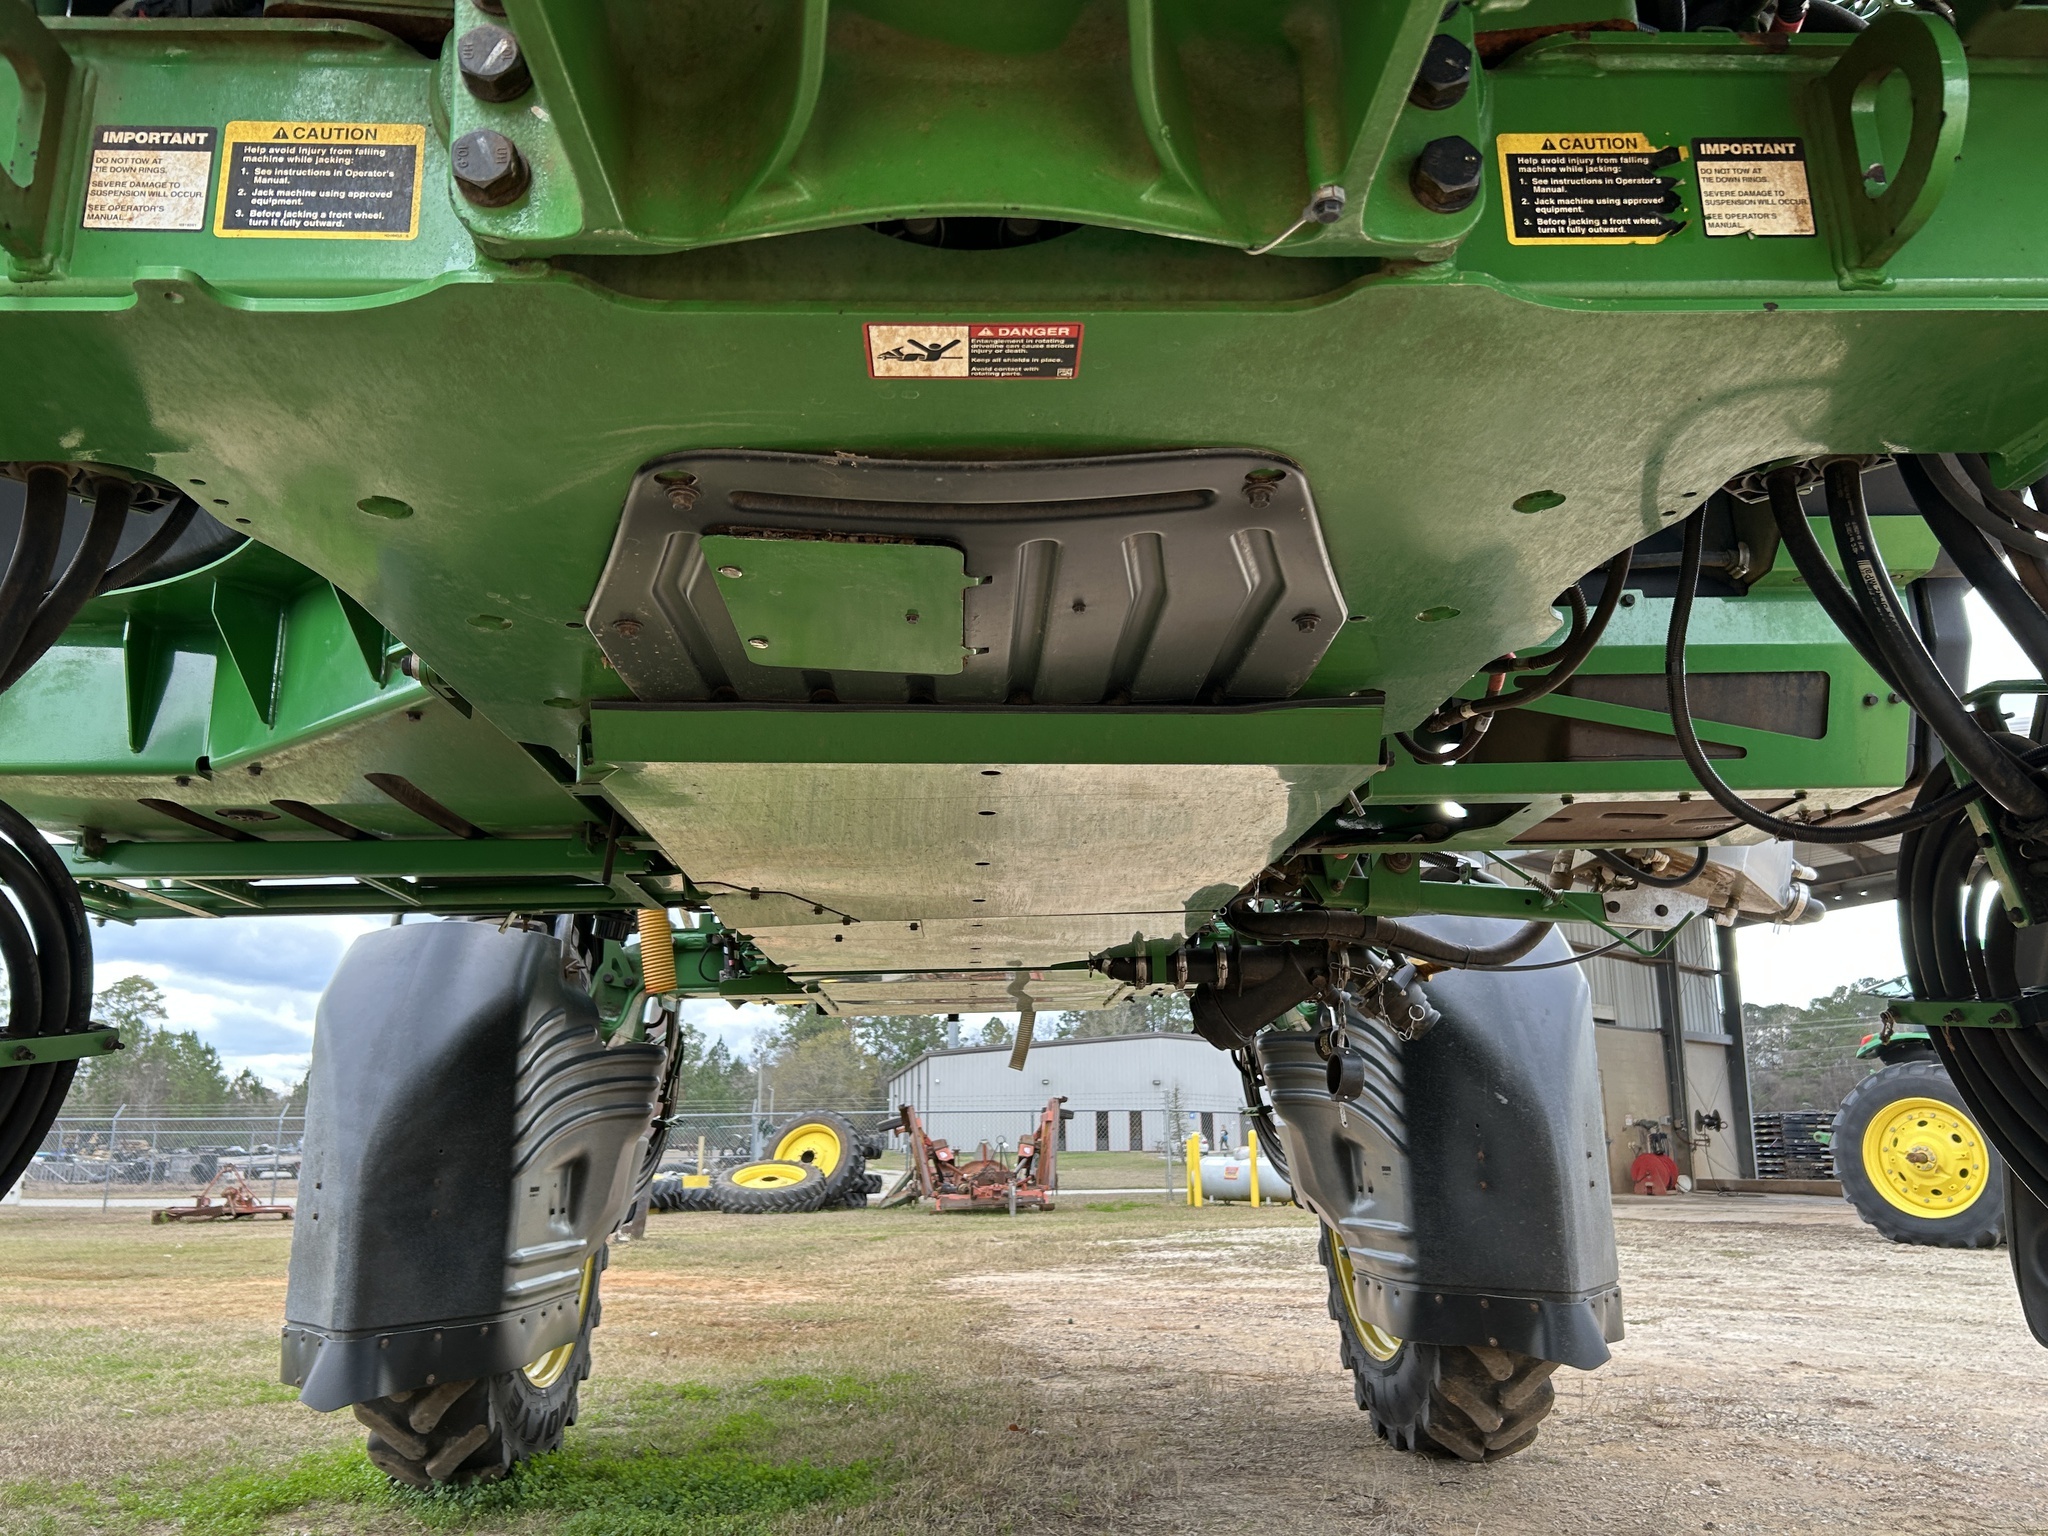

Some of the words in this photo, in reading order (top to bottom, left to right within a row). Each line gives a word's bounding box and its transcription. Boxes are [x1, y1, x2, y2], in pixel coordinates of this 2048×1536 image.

[103, 131, 208, 144] IMPORTANT
[293, 127, 377, 140] CAUTION
[1559, 138, 1637, 150] CAUTION
[1700, 143, 1796, 154] IMPORTANT
[244, 146, 266, 154] Help
[298, 147, 326, 156] injury
[354, 148, 386, 156] falling
[243, 155, 284, 163] machine
[315, 156, 354, 165] jacking:
[1517, 157, 1538, 165] Help
[1568, 157, 1593, 165] injury
[1620, 157, 1649, 165] falling
[254, 168, 272, 176] See
[274, 168, 331, 177] instructions
[333, 169, 343, 177] in
[345, 170, 394, 178] Operator's
[1585, 166, 1622, 174] jacking:
[1615, 178, 1662, 186] Operator's
[319, 190, 345, 199] using
[347, 191, 392, 199] approved
[251, 198, 303, 206] equipment.
[1597, 198, 1621, 206] using
[1623, 197, 1664, 205] approved
[1535, 206, 1584, 214] equipment.
[250, 210, 281, 218] Before
[283, 211, 318, 220] jacking
[280, 219, 301, 228] fully
[303, 220, 344, 228] outward.
[1568, 218, 1600, 227] jacking
[1567, 226, 1586, 234] fully
[999, 328, 1070, 336] DANGER
